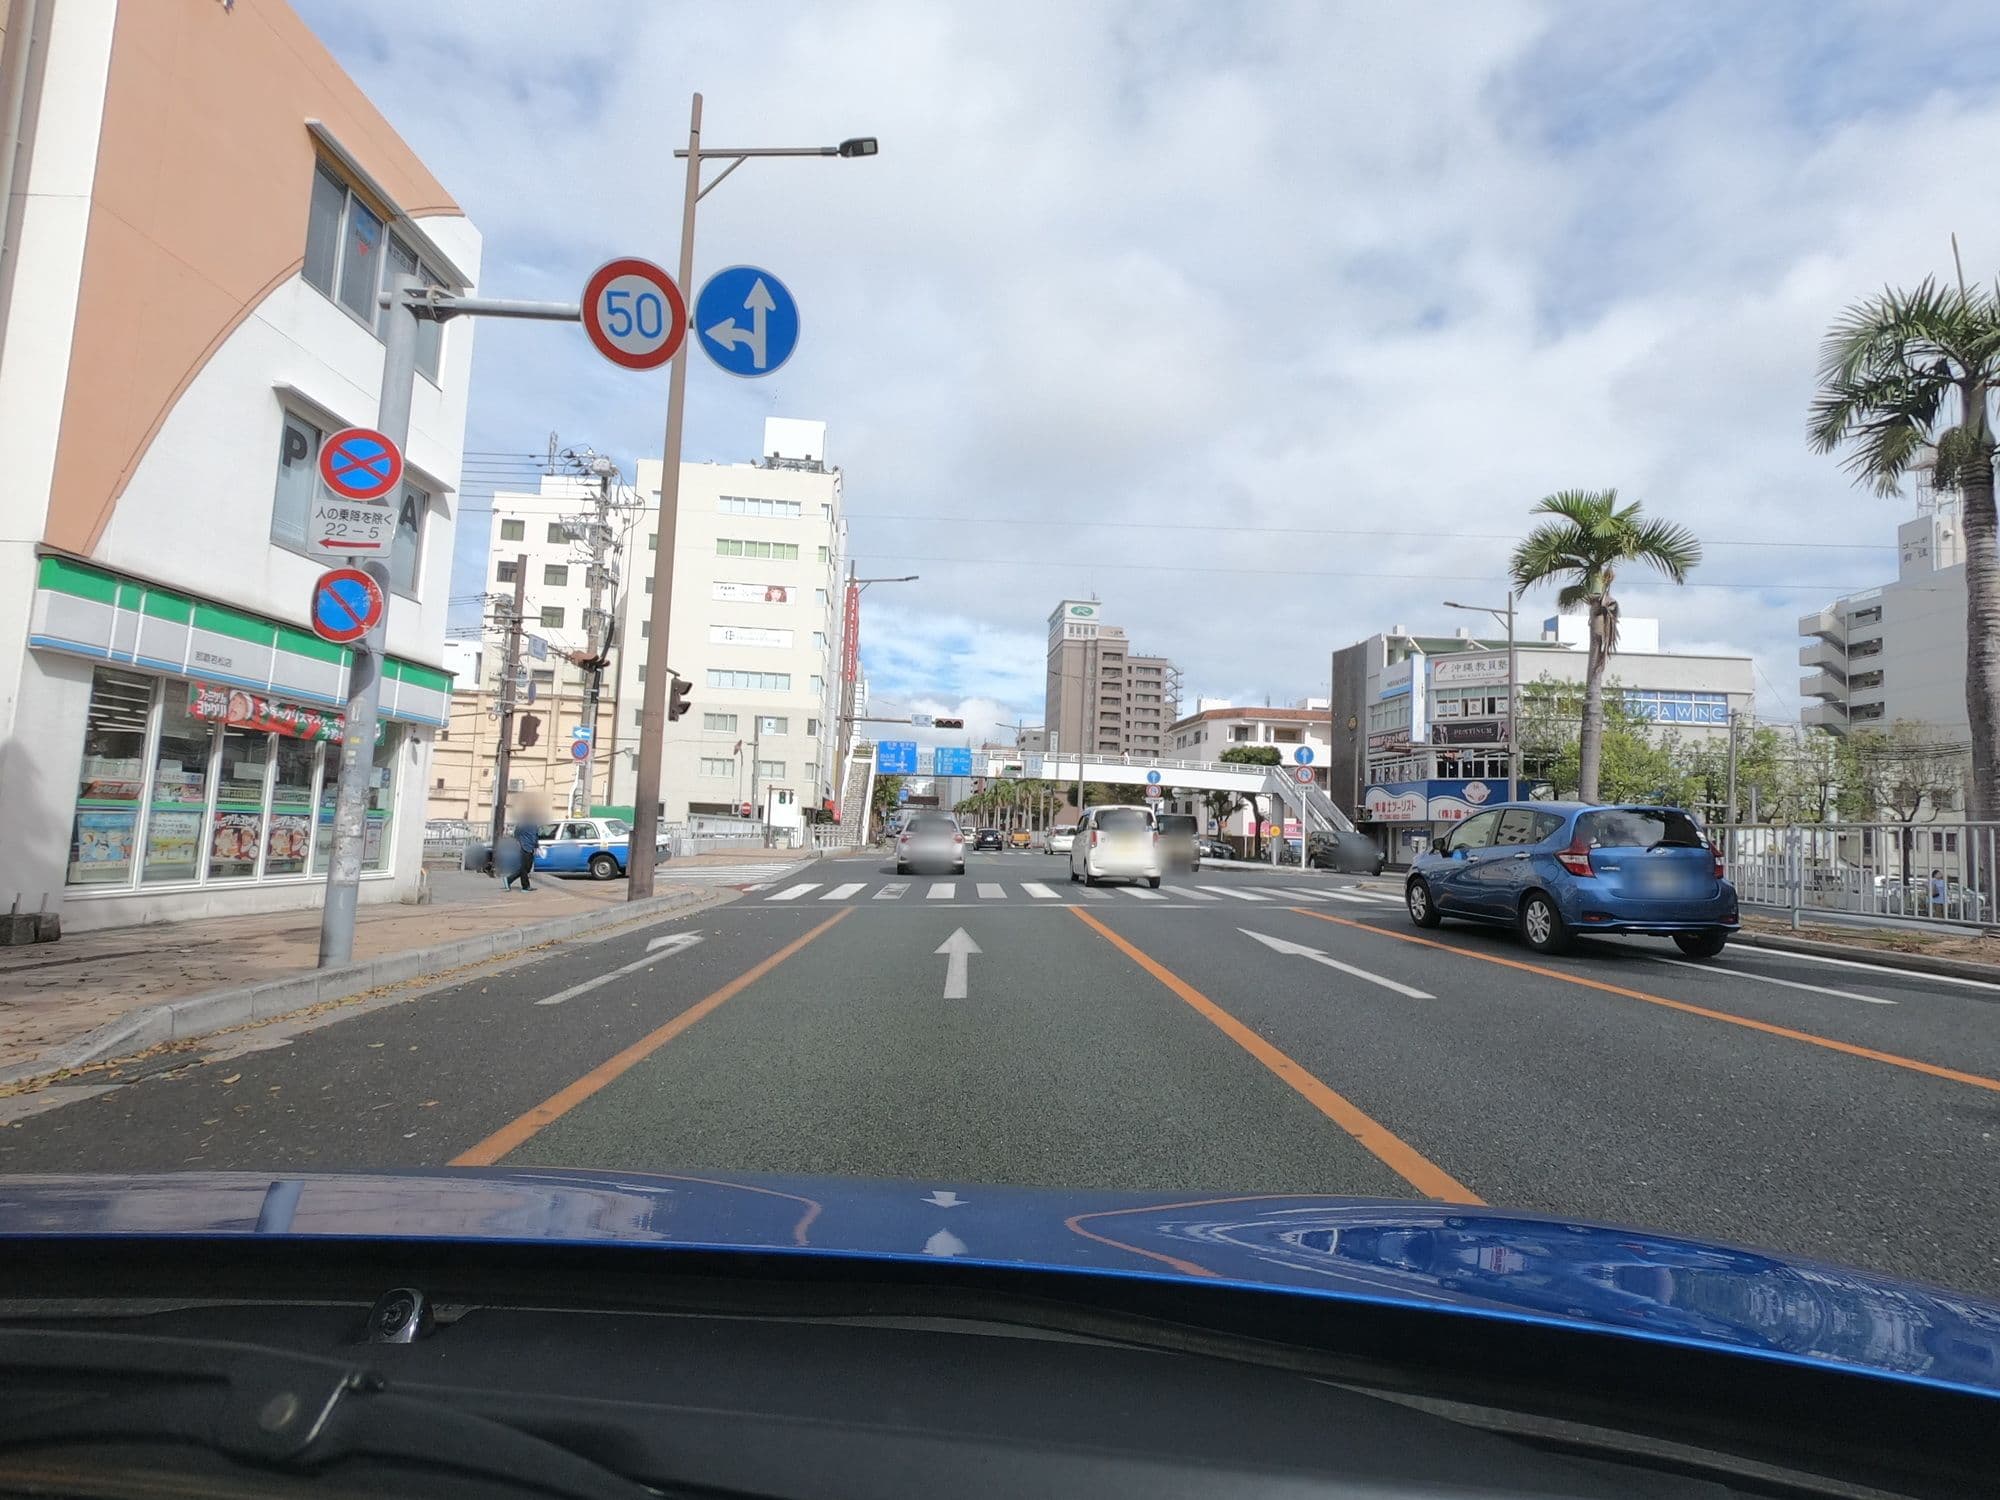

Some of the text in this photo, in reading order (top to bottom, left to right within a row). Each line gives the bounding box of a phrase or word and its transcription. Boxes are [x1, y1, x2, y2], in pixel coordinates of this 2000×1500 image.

[606, 290, 663, 339] 50
[315, 506, 393, 526] 人の乗降を除く
[1676, 707, 1724, 720] WING
[1453, 726, 1493, 738] PLATINUM
